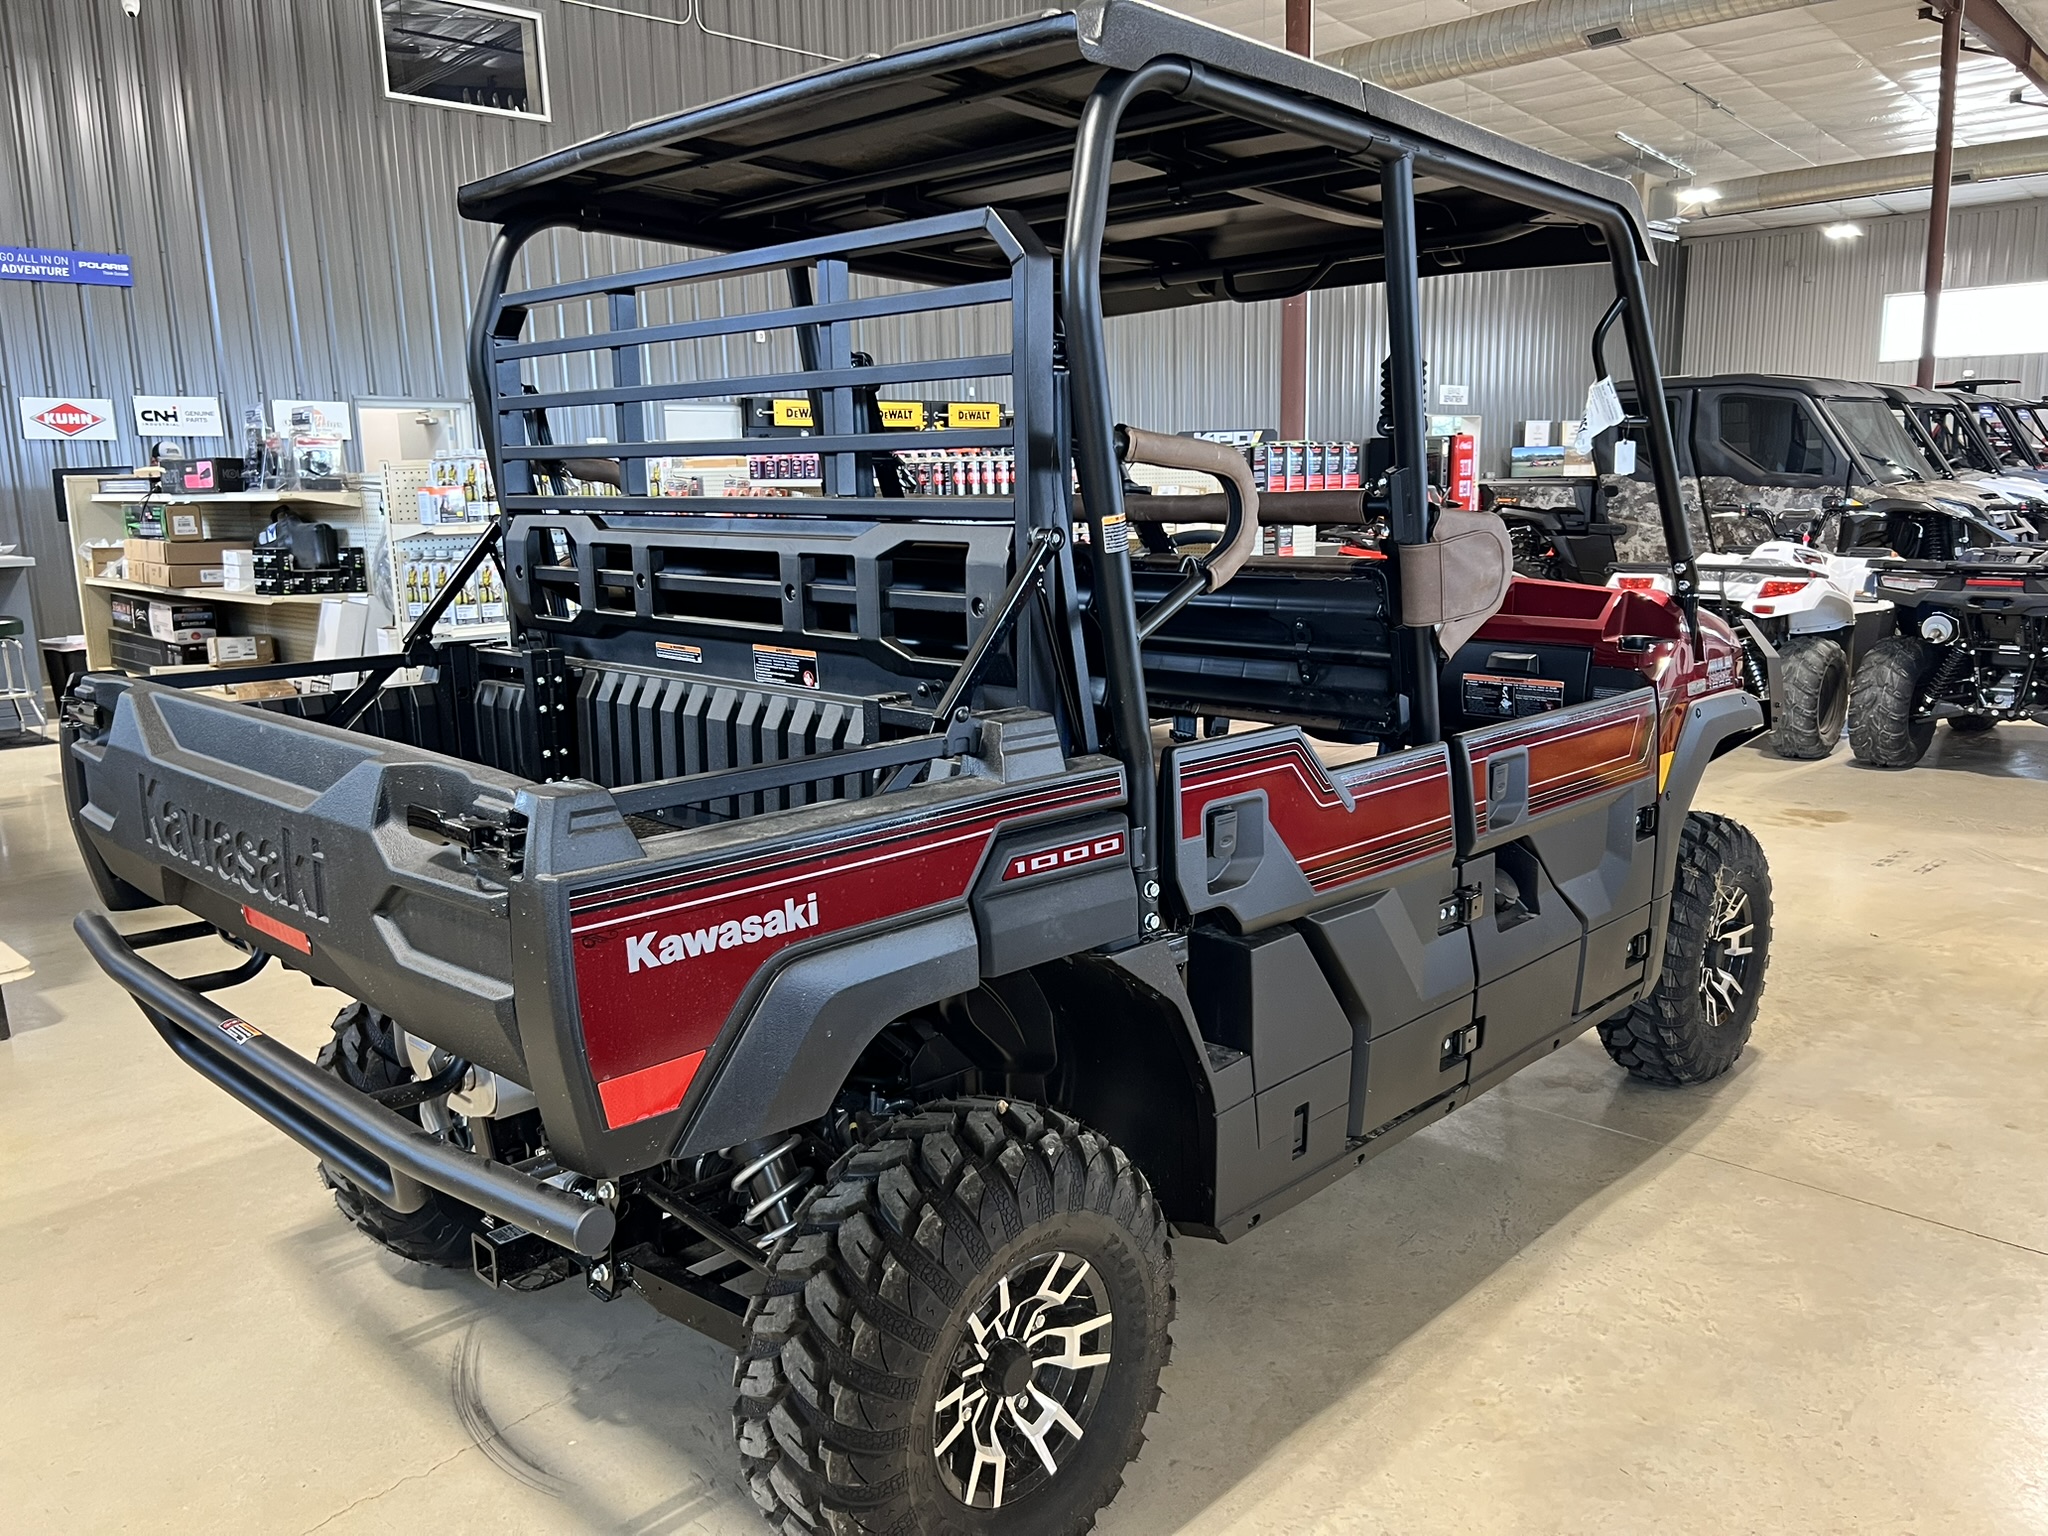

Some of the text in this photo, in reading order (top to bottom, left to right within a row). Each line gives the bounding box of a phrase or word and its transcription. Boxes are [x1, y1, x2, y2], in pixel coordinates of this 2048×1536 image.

[0, 252, 69, 265] GO ALL IN ON
[1, 263, 70, 277] ADVENTURE
[78, 261, 129, 271] POLARIS
[42, 412, 94, 425] KUHN
[138, 773, 330, 924] Kawasaki
[1014, 837, 1120, 874] 1000
[626, 892, 819, 973] Kawasaki
